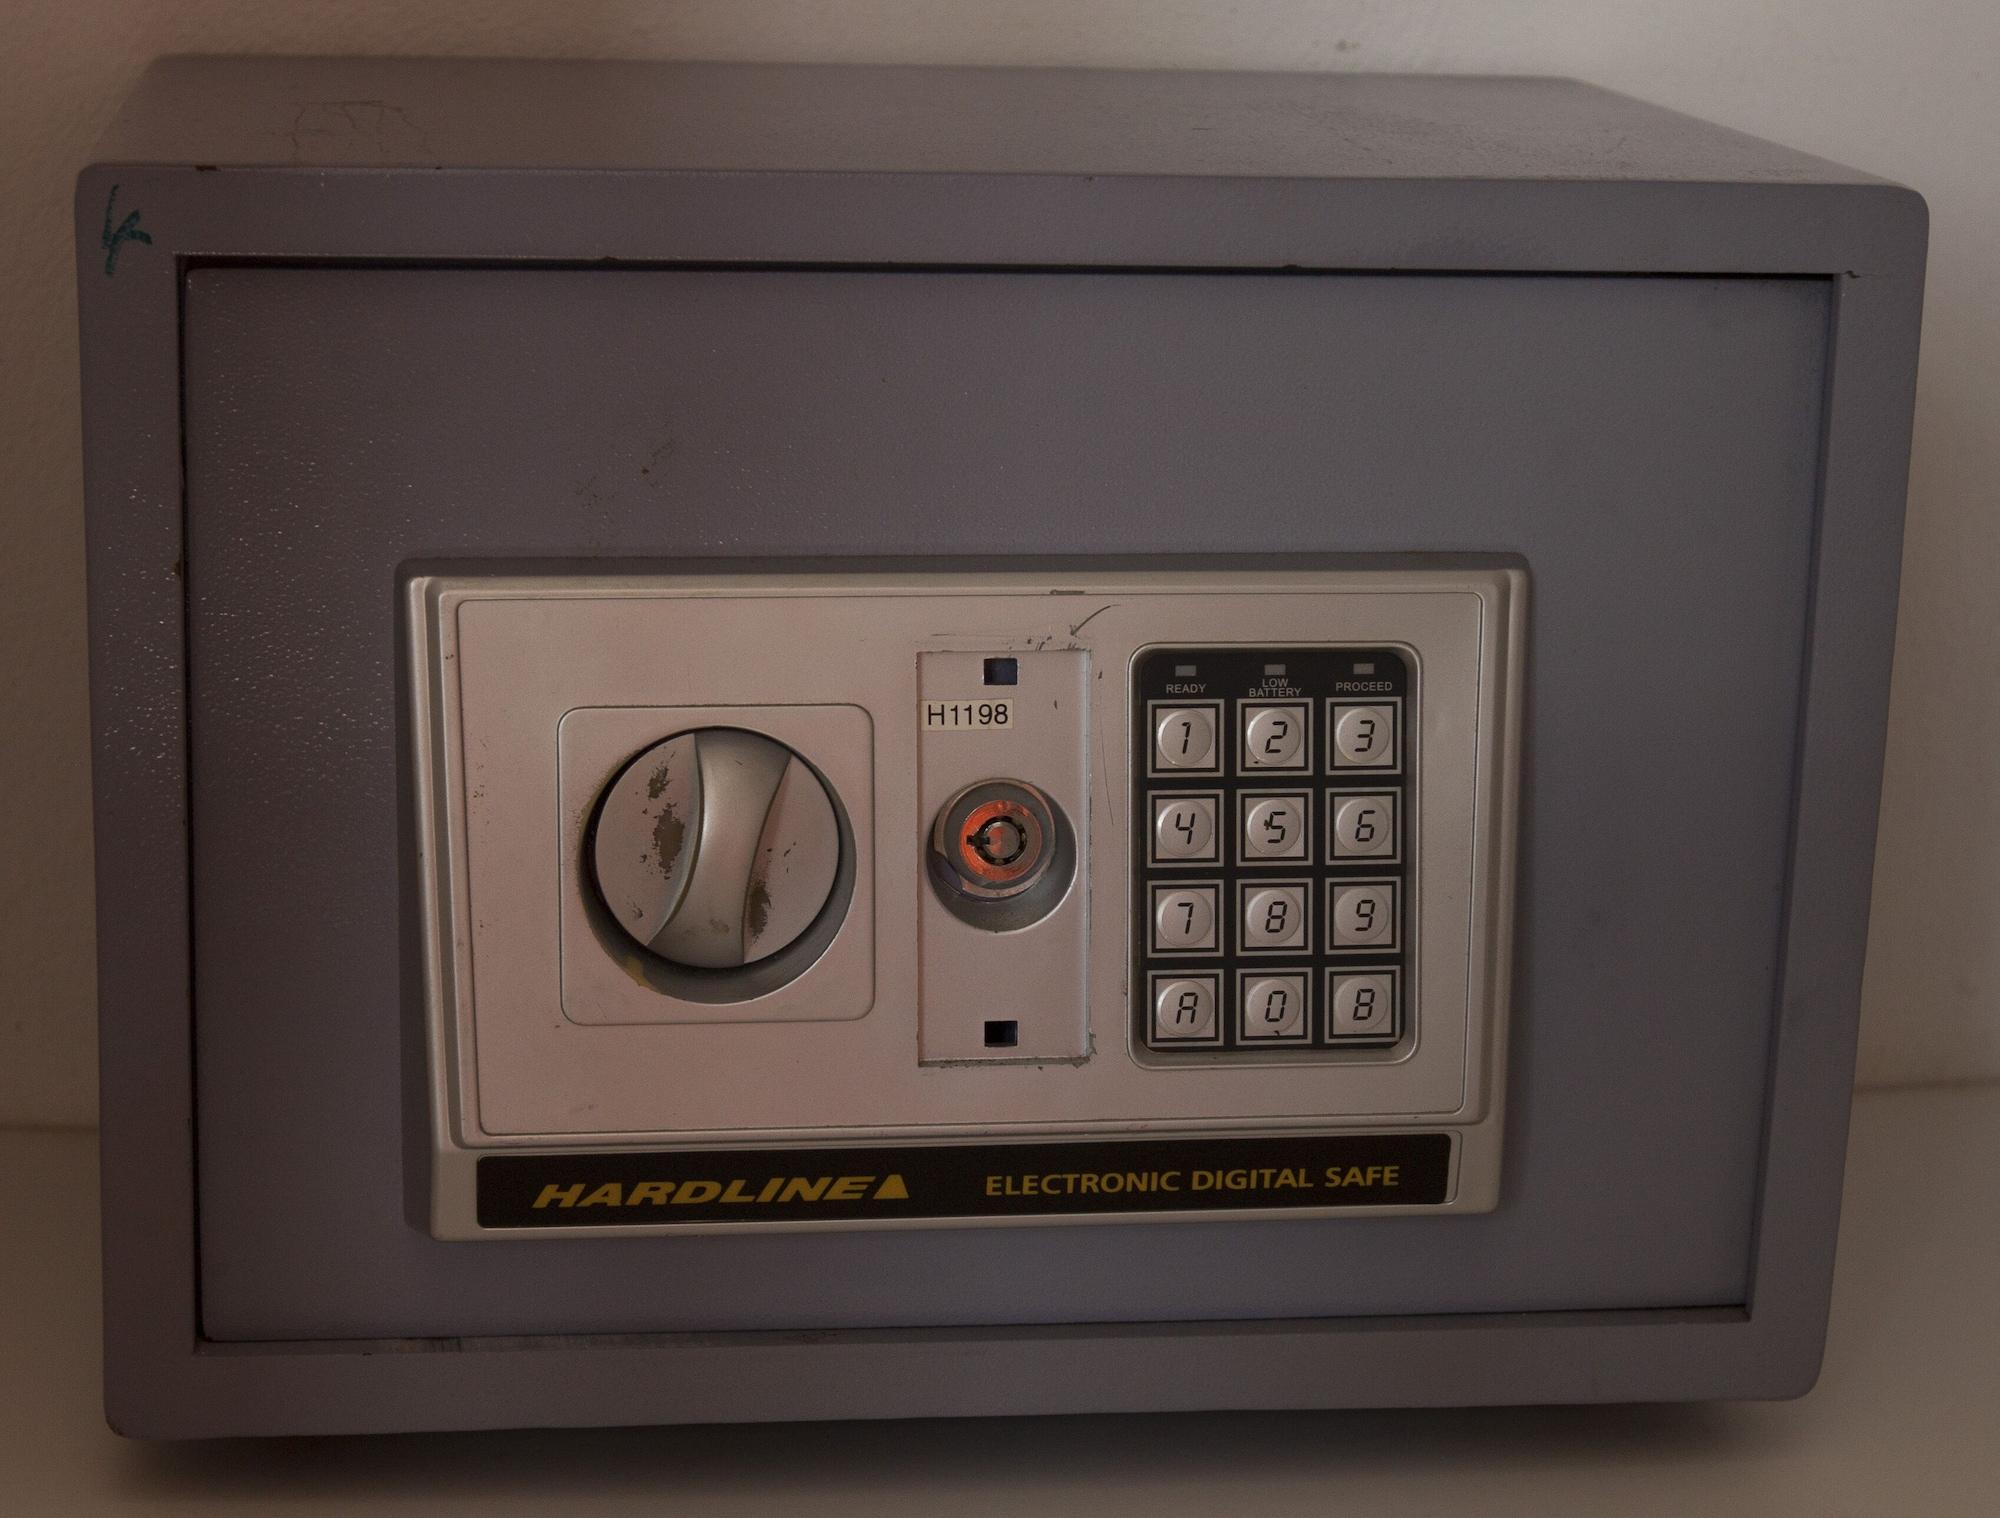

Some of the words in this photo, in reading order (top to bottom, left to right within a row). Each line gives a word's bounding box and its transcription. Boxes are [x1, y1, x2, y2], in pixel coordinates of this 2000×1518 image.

[1166, 684, 1207, 693] READY
[1249, 687, 1301, 697] BATTERY
[1262, 678, 1288, 688] LOW
[1336, 681, 1392, 691] PROCEED
[927, 704, 1008, 725] H1198
[1182, 722, 1192, 754] 1
[1265, 721, 1288, 753] 2
[1354, 720, 1375, 753] 3
[1175, 813, 1195, 844] 4
[1267, 811, 1287, 844] 5
[1355, 810, 1376, 842] 6
[1178, 903, 1193, 934] 7
[1265, 901, 1288, 933] 8
[1355, 899, 1375, 931] 9
[1176, 992, 1198, 1024] A
[1265, 990, 1287, 1022] 0
[533, 1175, 880, 1209] HARDLINE
[985, 1170, 1182, 1197] ELECTRONIC
[1191, 1168, 1313, 1192] DIGITAL
[1324, 1165, 1400, 1188] SAFE
